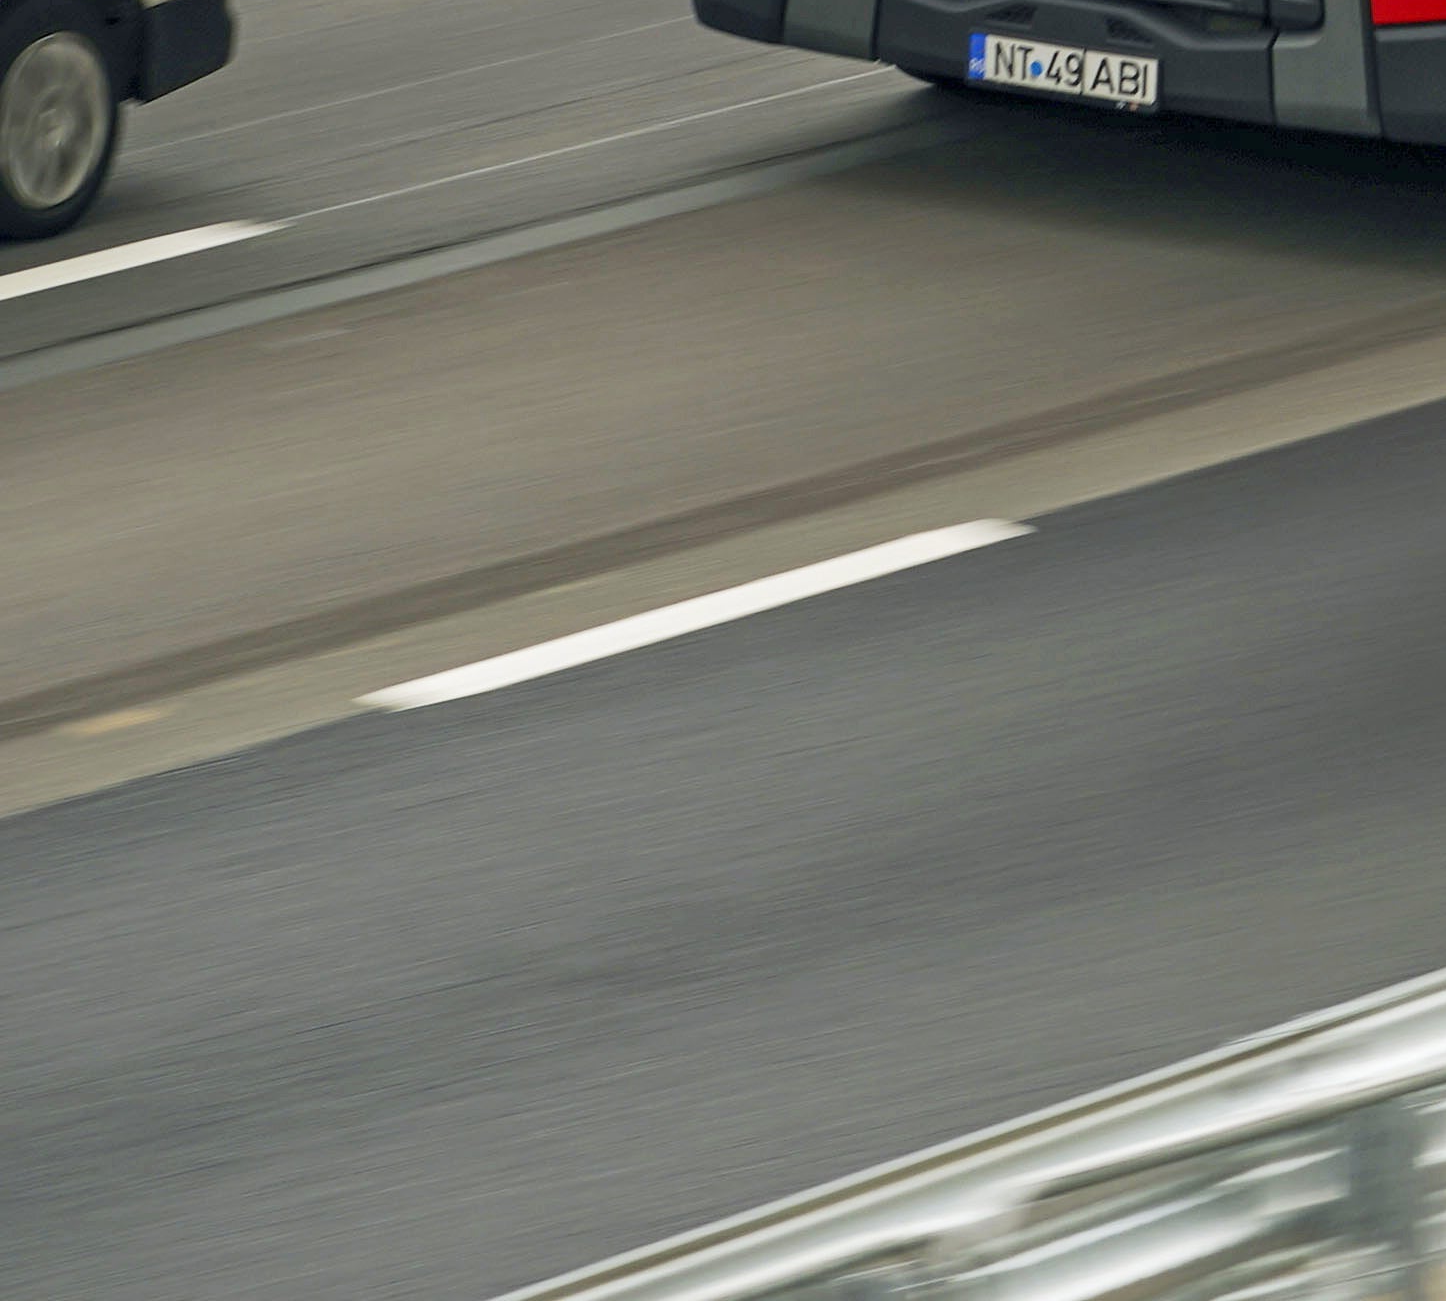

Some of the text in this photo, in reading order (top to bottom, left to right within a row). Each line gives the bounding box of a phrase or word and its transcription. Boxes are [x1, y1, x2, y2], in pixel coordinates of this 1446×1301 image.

[993, 41, 1149, 99] NT 49 ABI
